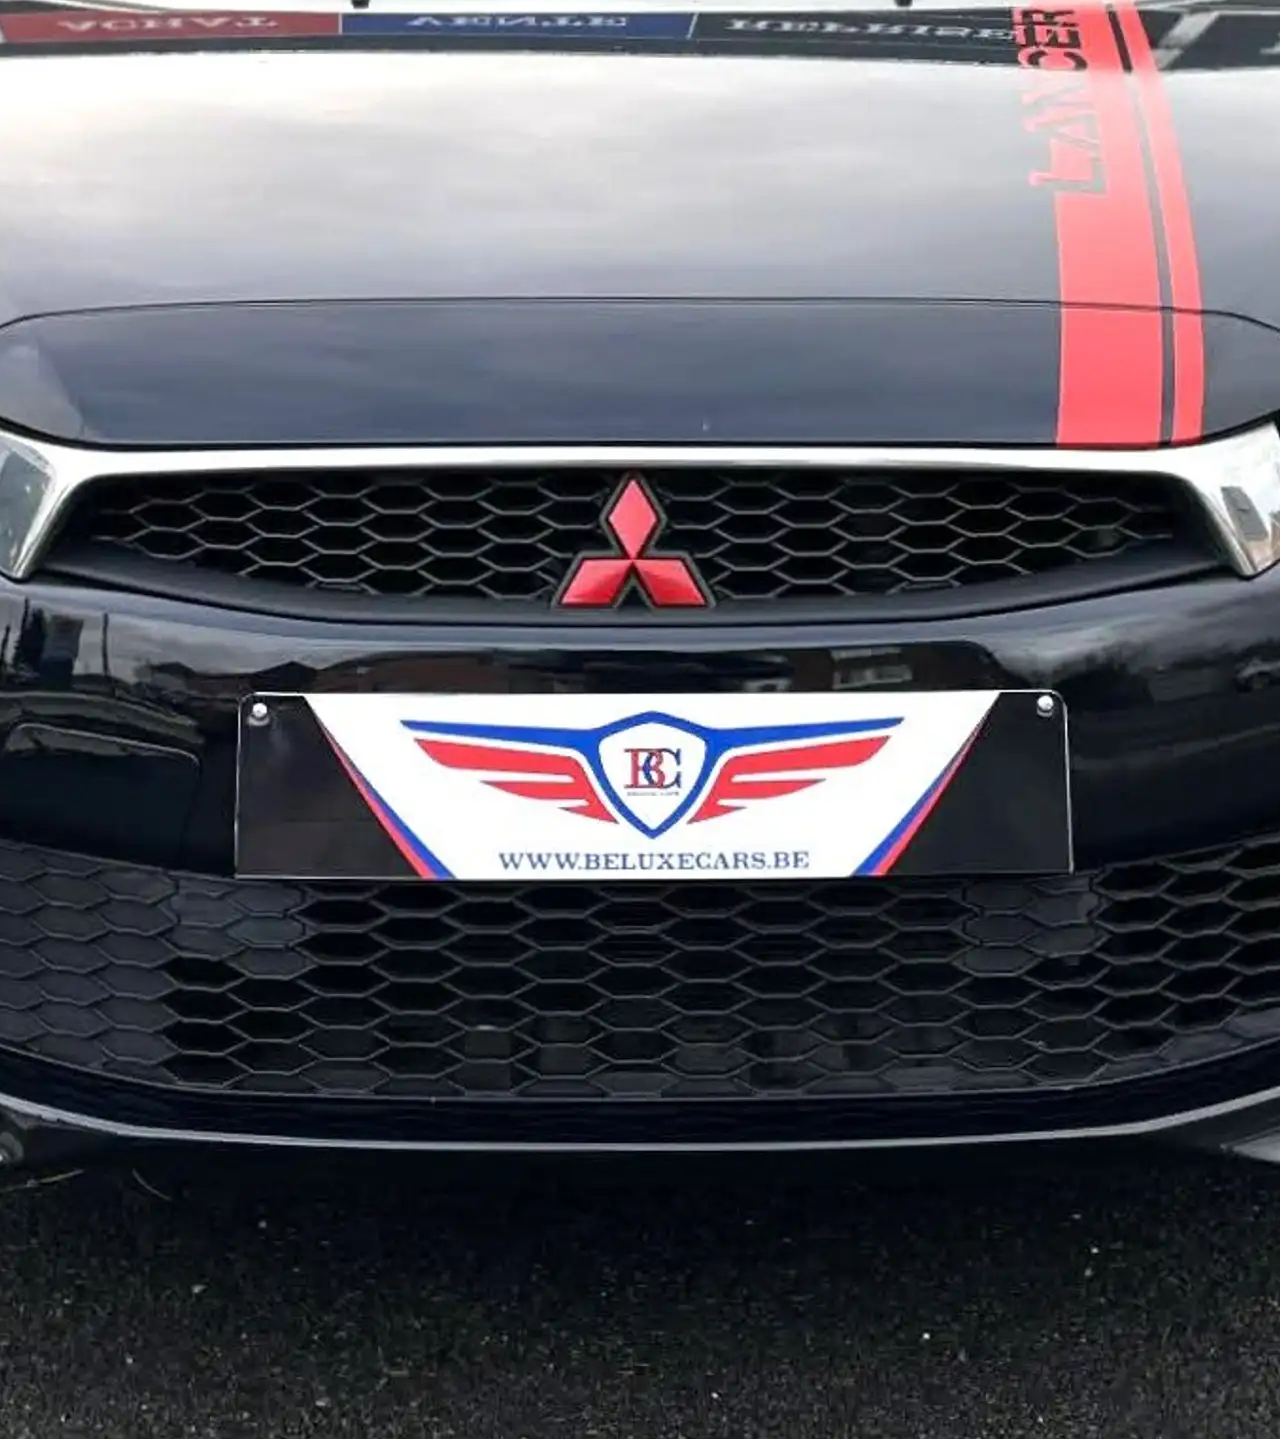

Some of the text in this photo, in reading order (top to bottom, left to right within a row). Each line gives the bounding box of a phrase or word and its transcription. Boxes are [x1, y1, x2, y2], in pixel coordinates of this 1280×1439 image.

[1012, 6, 1106, 193] LANCER
[624, 748, 682, 789] BC
[498, 851, 809, 870] WWW.BELUXECARS.BE
